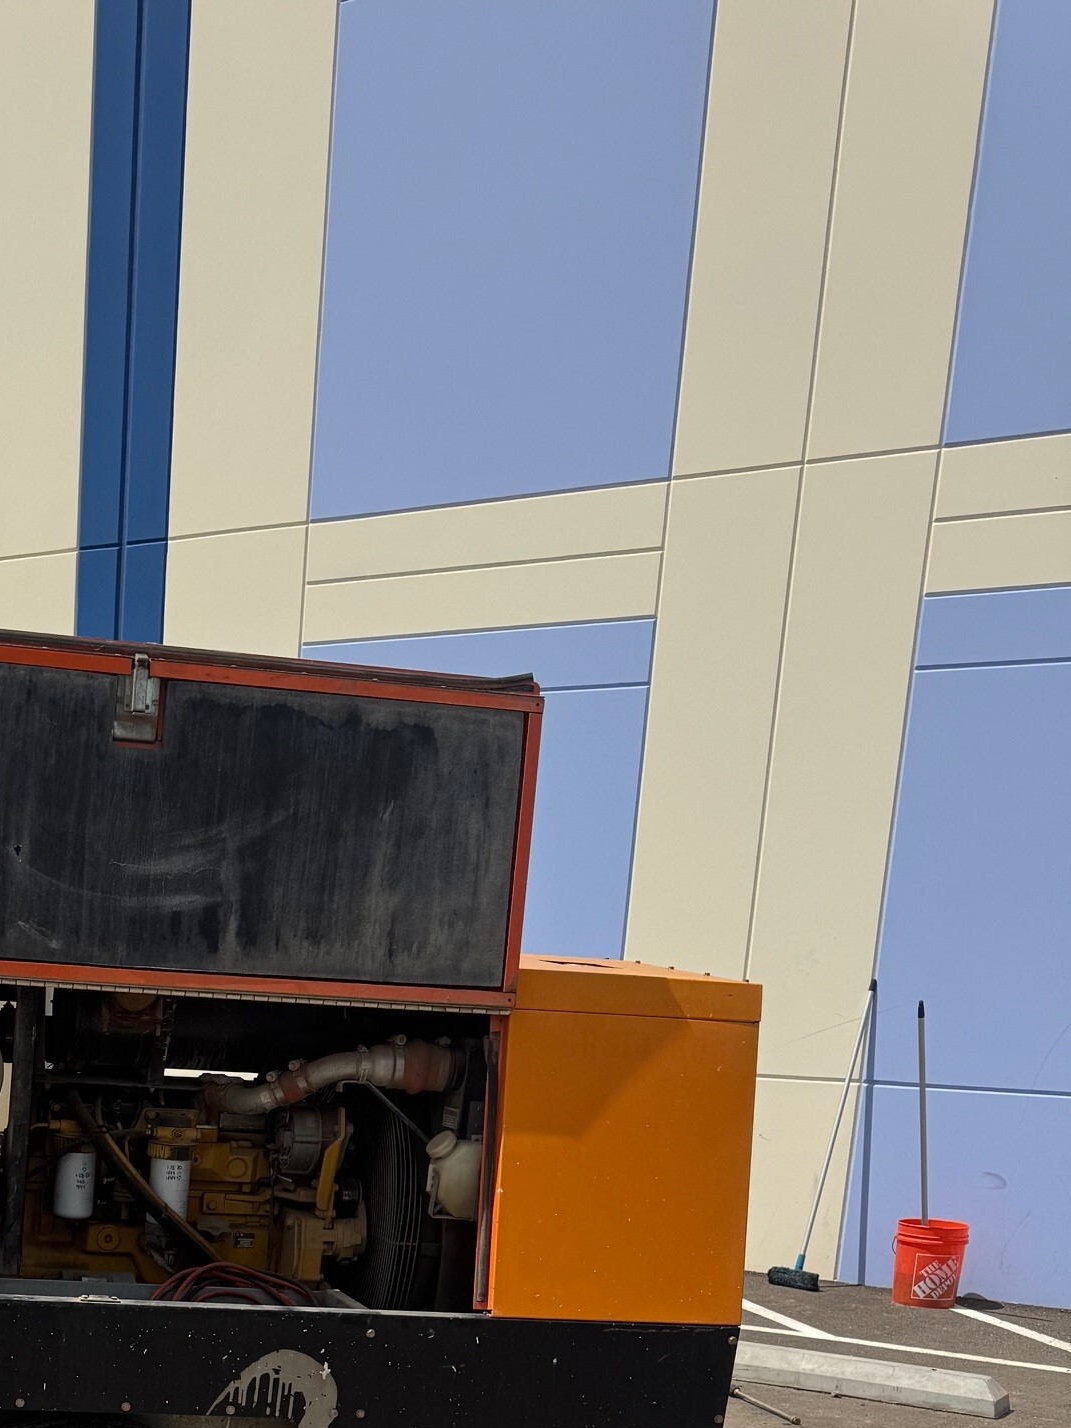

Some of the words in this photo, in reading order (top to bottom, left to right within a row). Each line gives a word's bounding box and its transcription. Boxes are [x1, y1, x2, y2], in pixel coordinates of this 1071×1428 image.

[913, 1256, 958, 1298] HOME
[920, 1260, 942, 1278] THE
[930, 1273, 956, 1299] DEPOT
